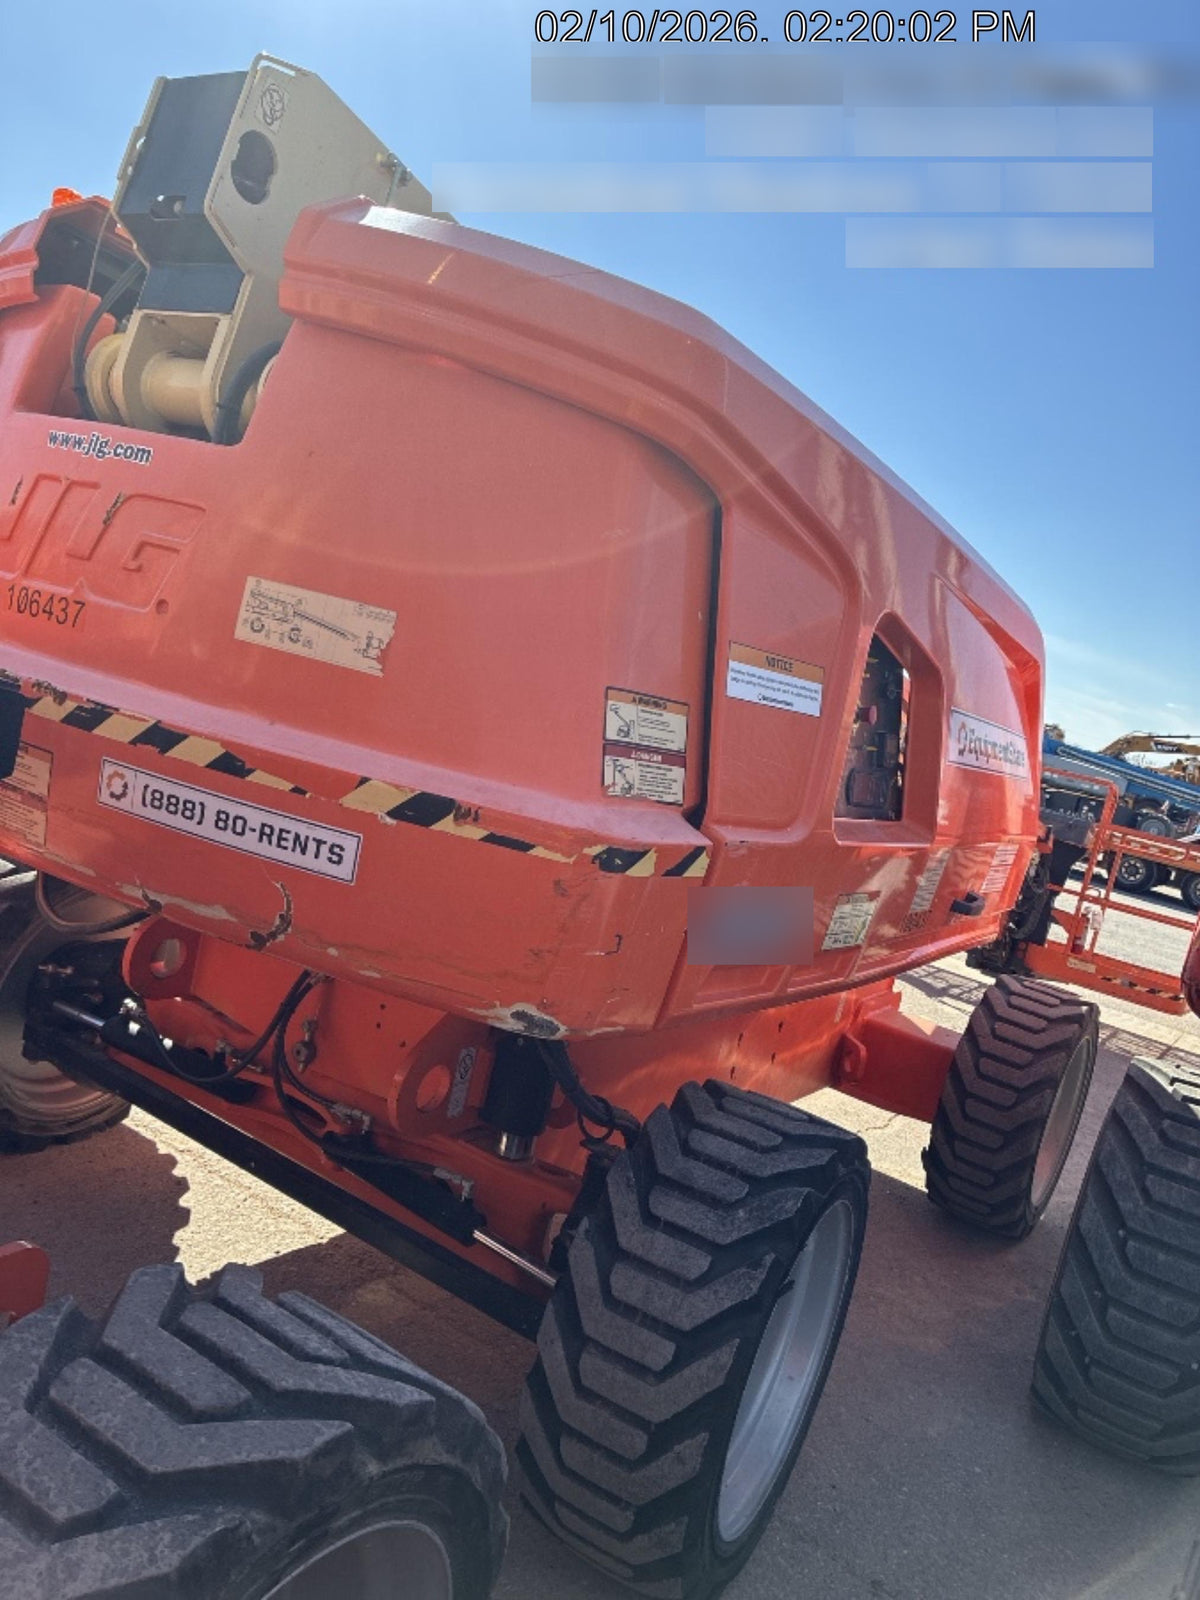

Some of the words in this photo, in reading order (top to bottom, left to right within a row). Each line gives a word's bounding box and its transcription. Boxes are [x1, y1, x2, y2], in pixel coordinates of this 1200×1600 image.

[48, 430, 153, 465] www.jlg.com
[8, 584, 86, 628] 106437
[142, 784, 206, 825] (888)
[214, 810, 347, 867] 80-RENTS
